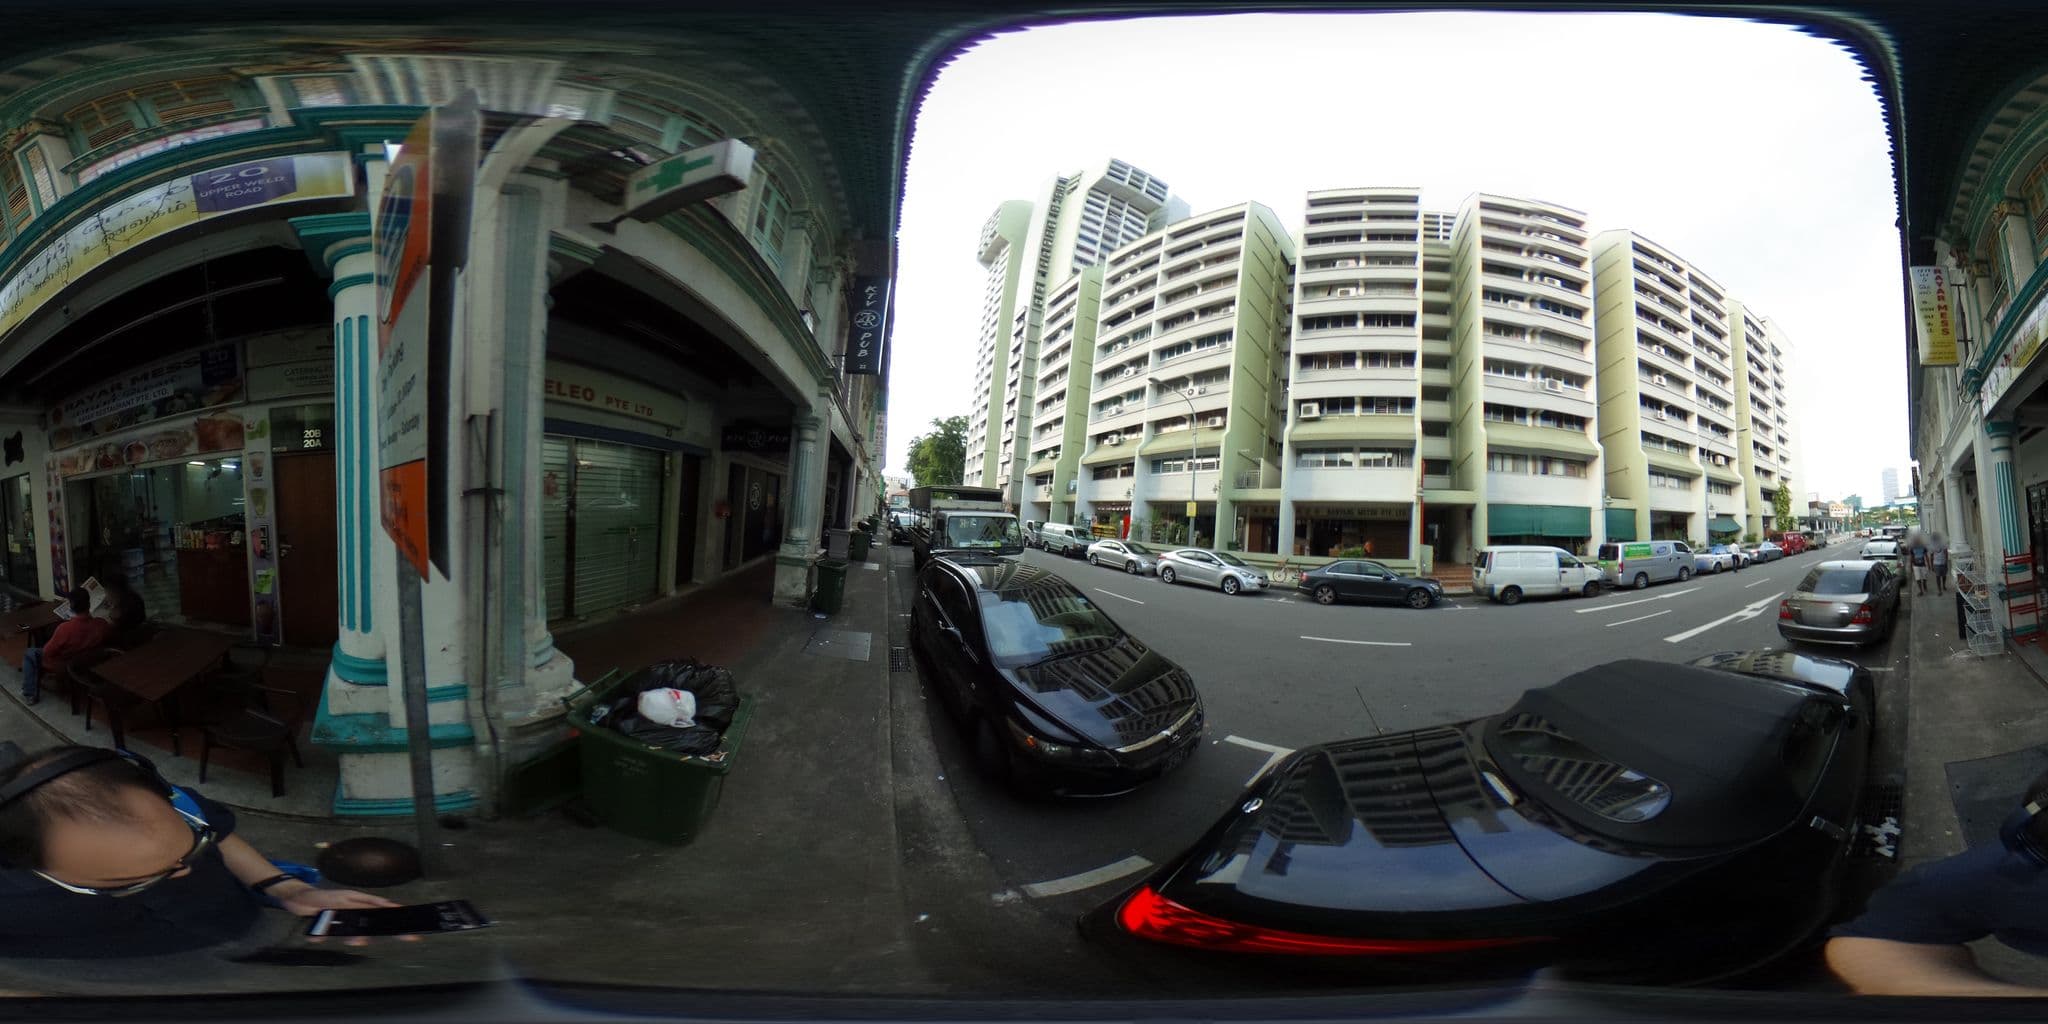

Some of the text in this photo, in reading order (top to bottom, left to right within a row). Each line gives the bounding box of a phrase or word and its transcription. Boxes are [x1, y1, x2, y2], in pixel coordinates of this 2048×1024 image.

[209, 166, 269, 185] 20
[199, 176, 286, 197] UPPER WELD
[224, 187, 262, 199] ROAD
[864, 285, 878, 307] KTV
[1933, 268, 1950, 336] RAYAR MESS
[856, 332, 873, 357] PUB
[606, 395, 630, 411] PTE
[634, 403, 653, 417] LTD
[303, 429, 321, 438] 20B
[303, 439, 322, 448] 20A
